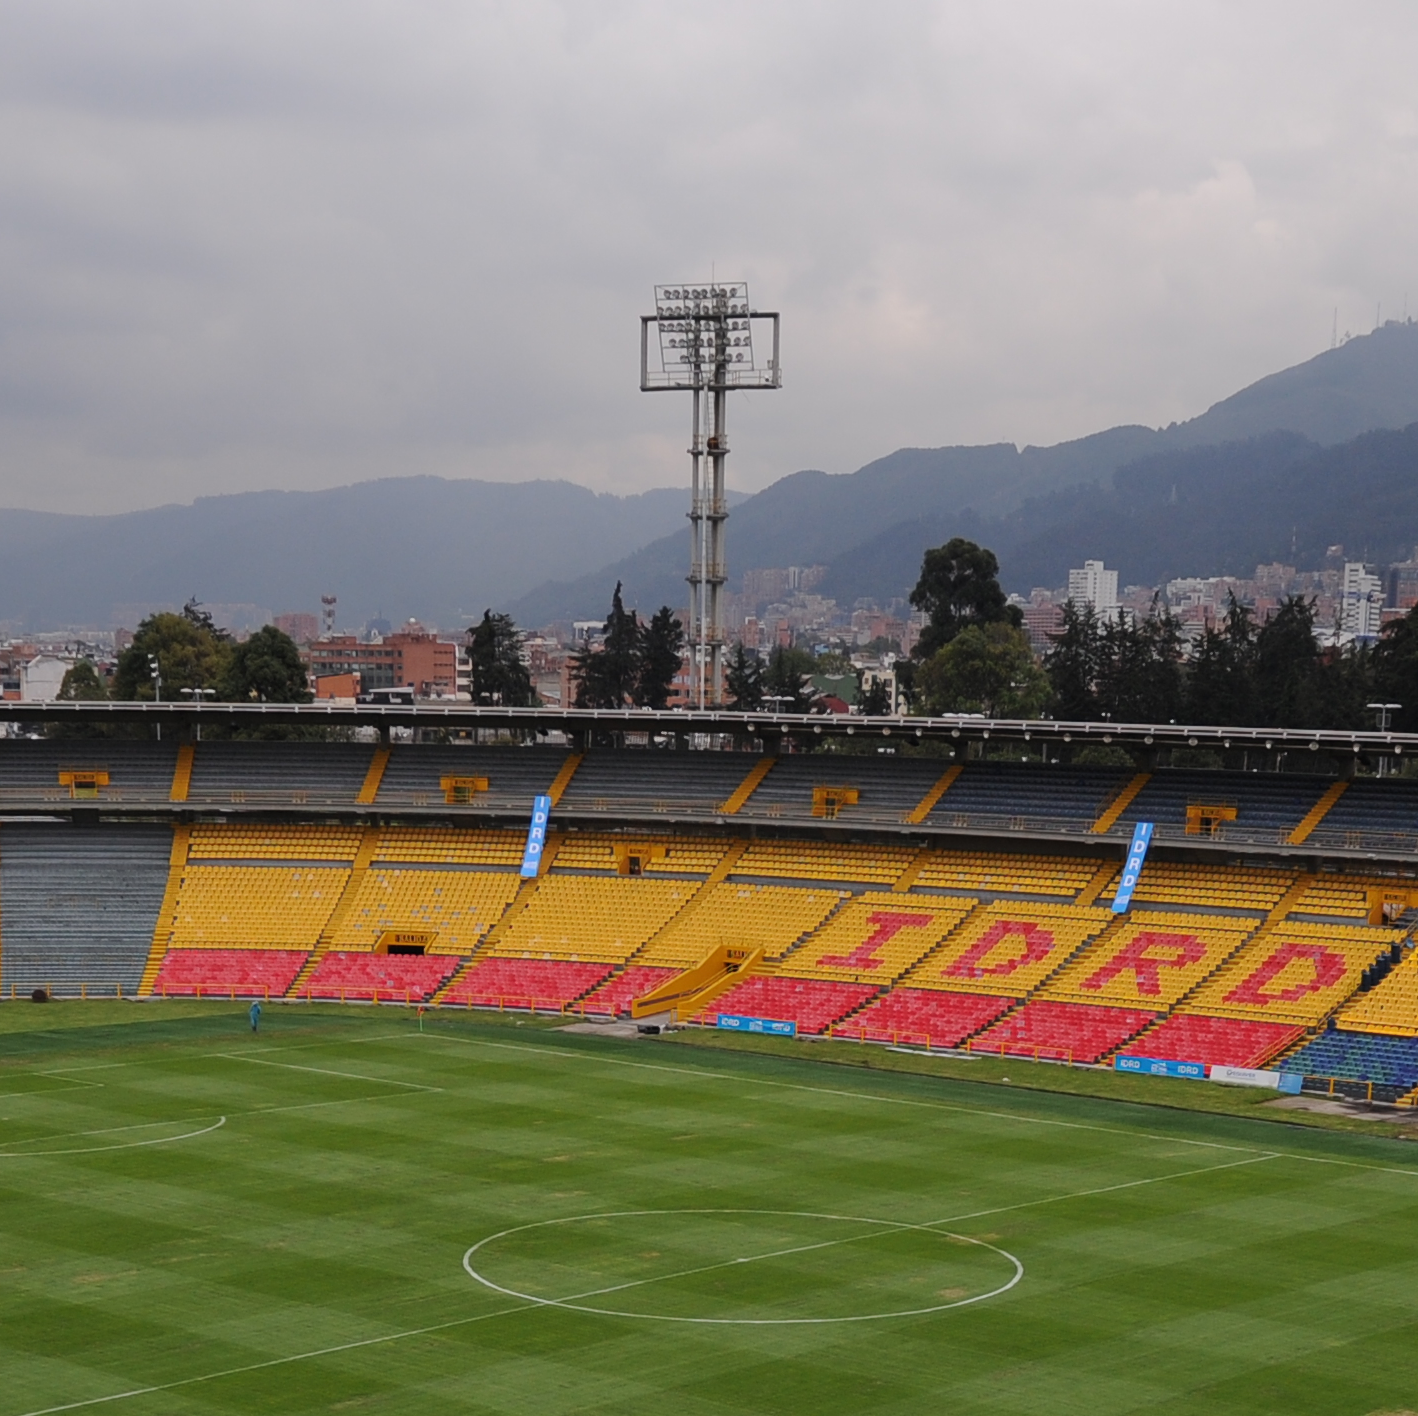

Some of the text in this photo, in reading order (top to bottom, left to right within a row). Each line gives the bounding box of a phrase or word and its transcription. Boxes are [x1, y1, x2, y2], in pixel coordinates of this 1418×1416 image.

[529, 796, 545, 854] IDRD
[1123, 823, 1147, 887] IDRD
[399, 934, 427, 943] SALIDA
[1120, 1059, 1140, 1069] IDRD
[1177, 1065, 1199, 1075] IDRD
